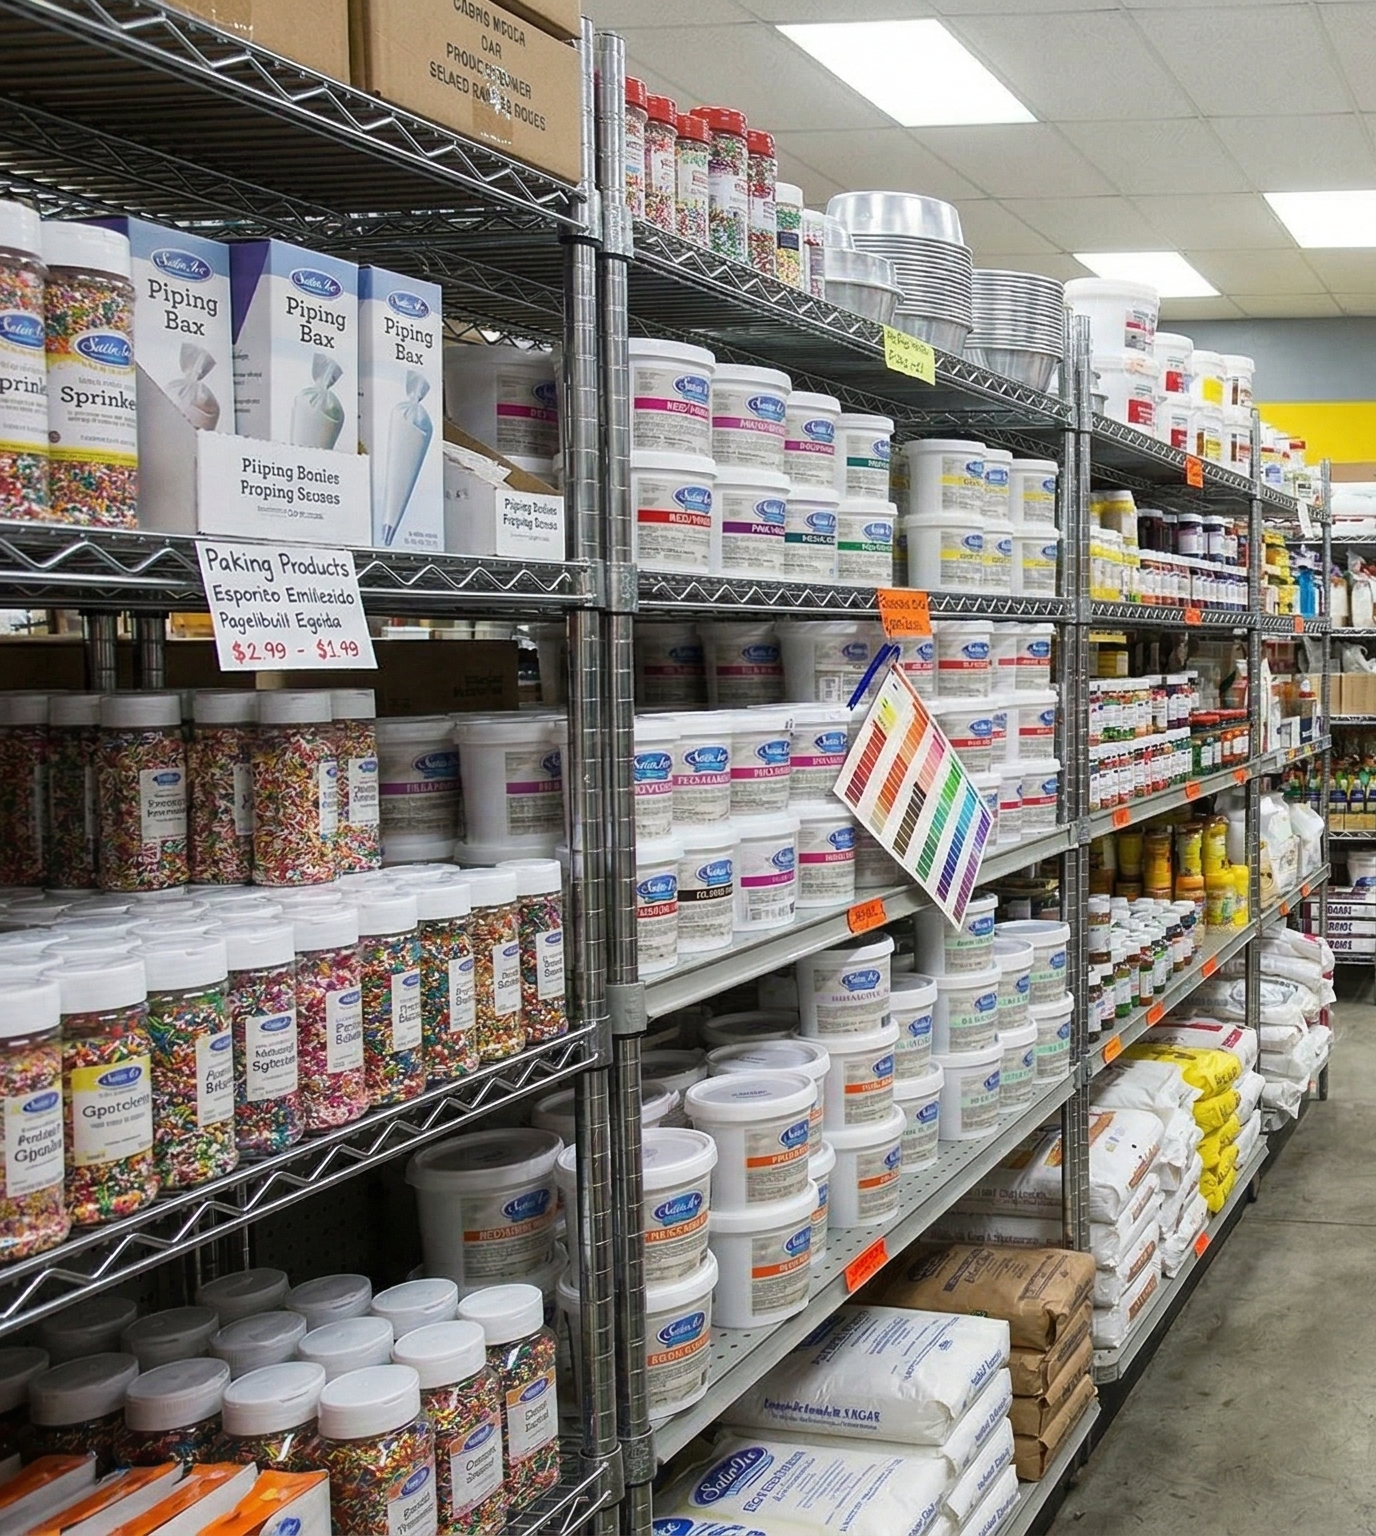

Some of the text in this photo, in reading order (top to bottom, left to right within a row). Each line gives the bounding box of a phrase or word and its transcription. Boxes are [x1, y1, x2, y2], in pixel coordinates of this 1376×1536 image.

[147, 278, 219, 318] Piping
[164, 309, 206, 337] Bax
[286, 296, 346, 332] Piping
[300, 324, 335, 349] Bax
[384, 317, 433, 349] Piping
[395, 343, 424, 366] Bax
[241, 480, 294, 504] Proping
[204, 547, 350, 583] Paking Products
[232, 640, 287, 664] $2.99
